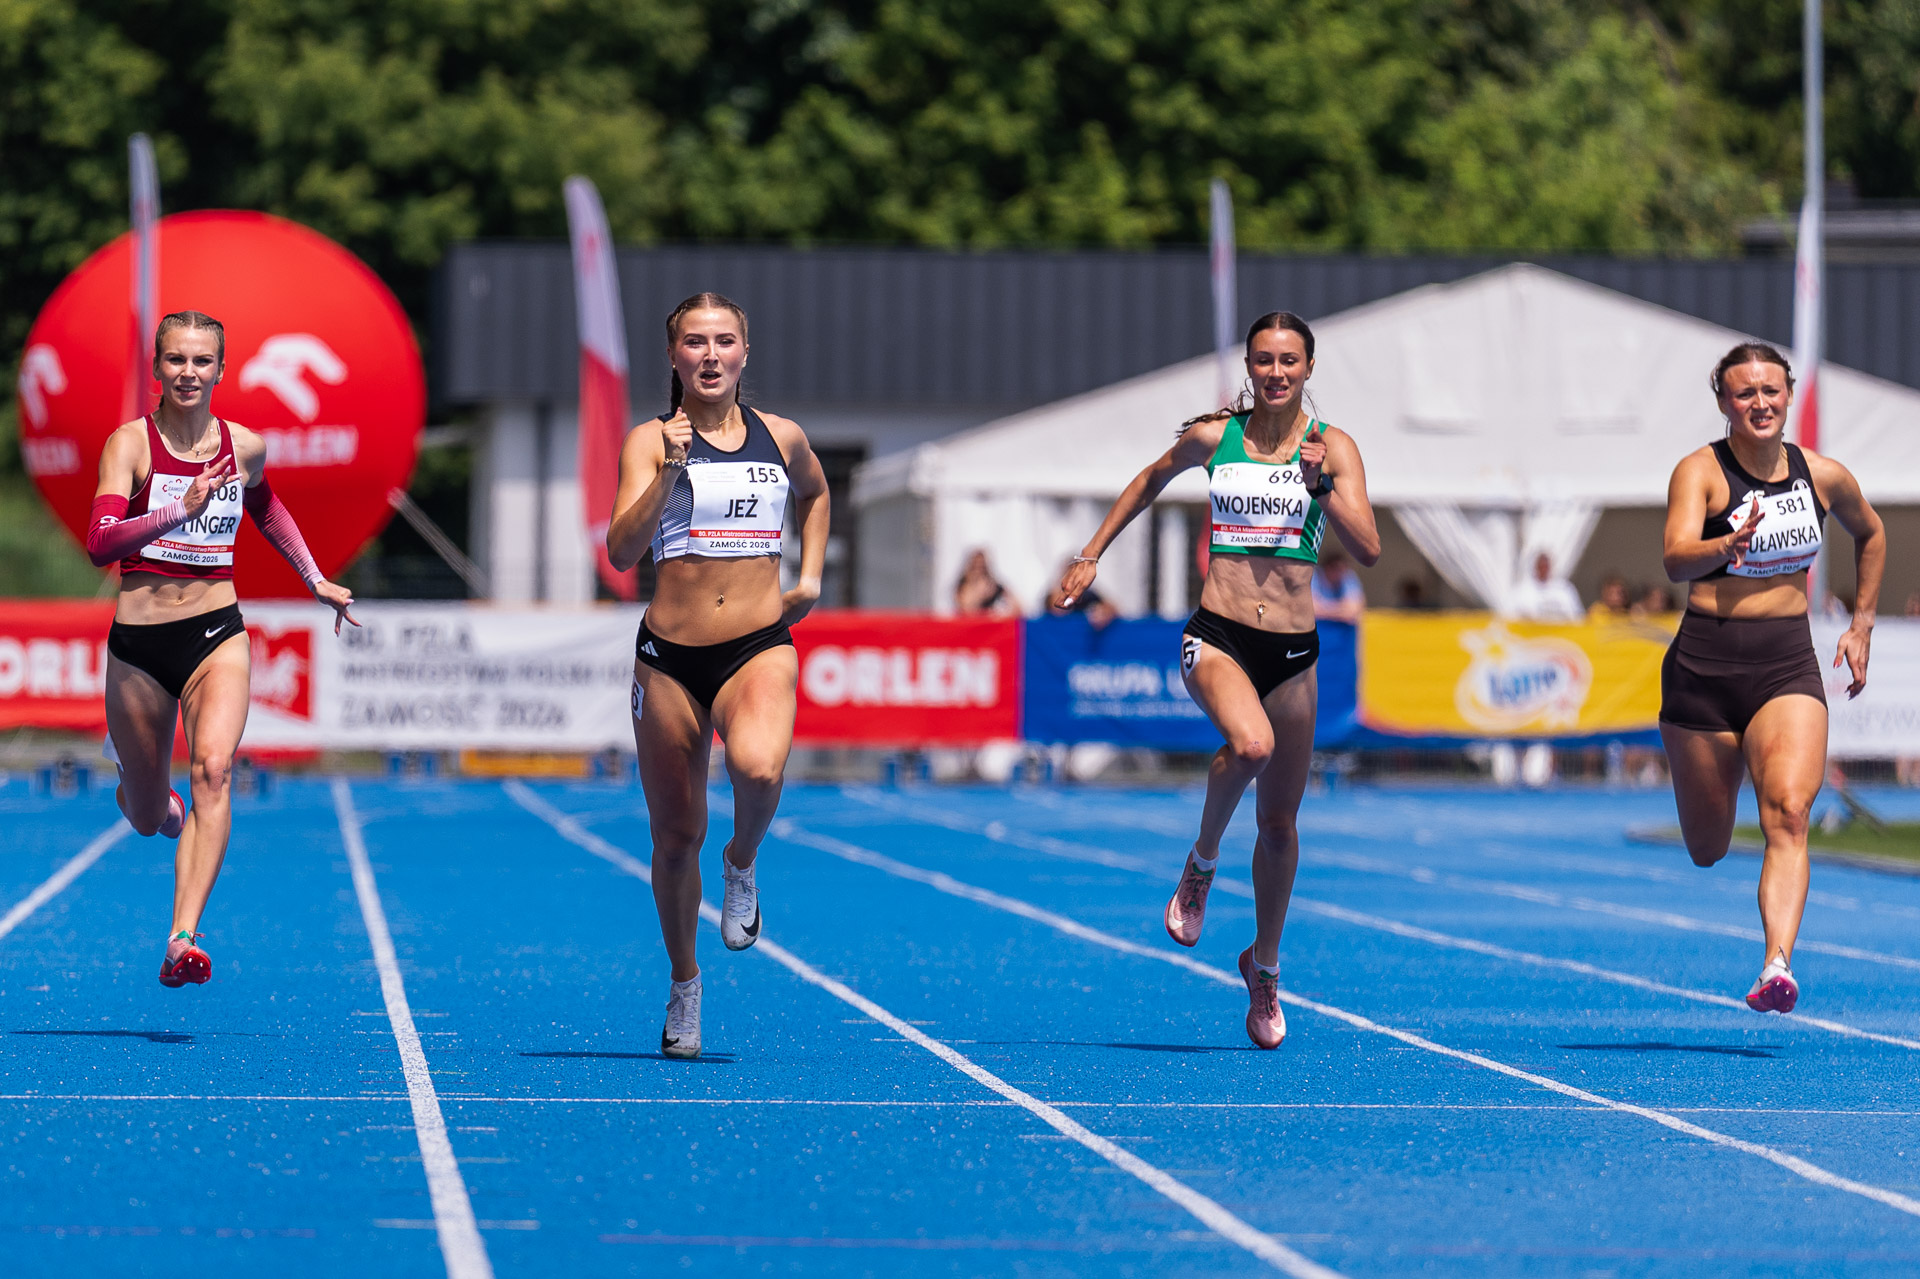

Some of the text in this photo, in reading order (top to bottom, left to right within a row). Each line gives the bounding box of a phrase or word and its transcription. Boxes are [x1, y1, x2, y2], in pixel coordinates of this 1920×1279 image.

[746, 467, 779, 483] 155
[1268, 470, 1304, 484] 696
[211, 485, 238, 502] 08
[724, 494, 758, 518] JEŻ
[1213, 493, 1303, 518] WOJEŃSKA
[1776, 496, 1807, 516] 581
[709, 539, 771, 549] ZAMOŚĆ 2026
[1230, 535, 1263, 543] ZAMOŚĆ
[1748, 525, 1819, 554] UŁAWSKA
[161, 551, 200, 562] ZAMOŚĆ
[1182, 639, 1196, 669] 5
[801, 645, 999, 708] ORLEN
[631, 681, 640, 711] 6
